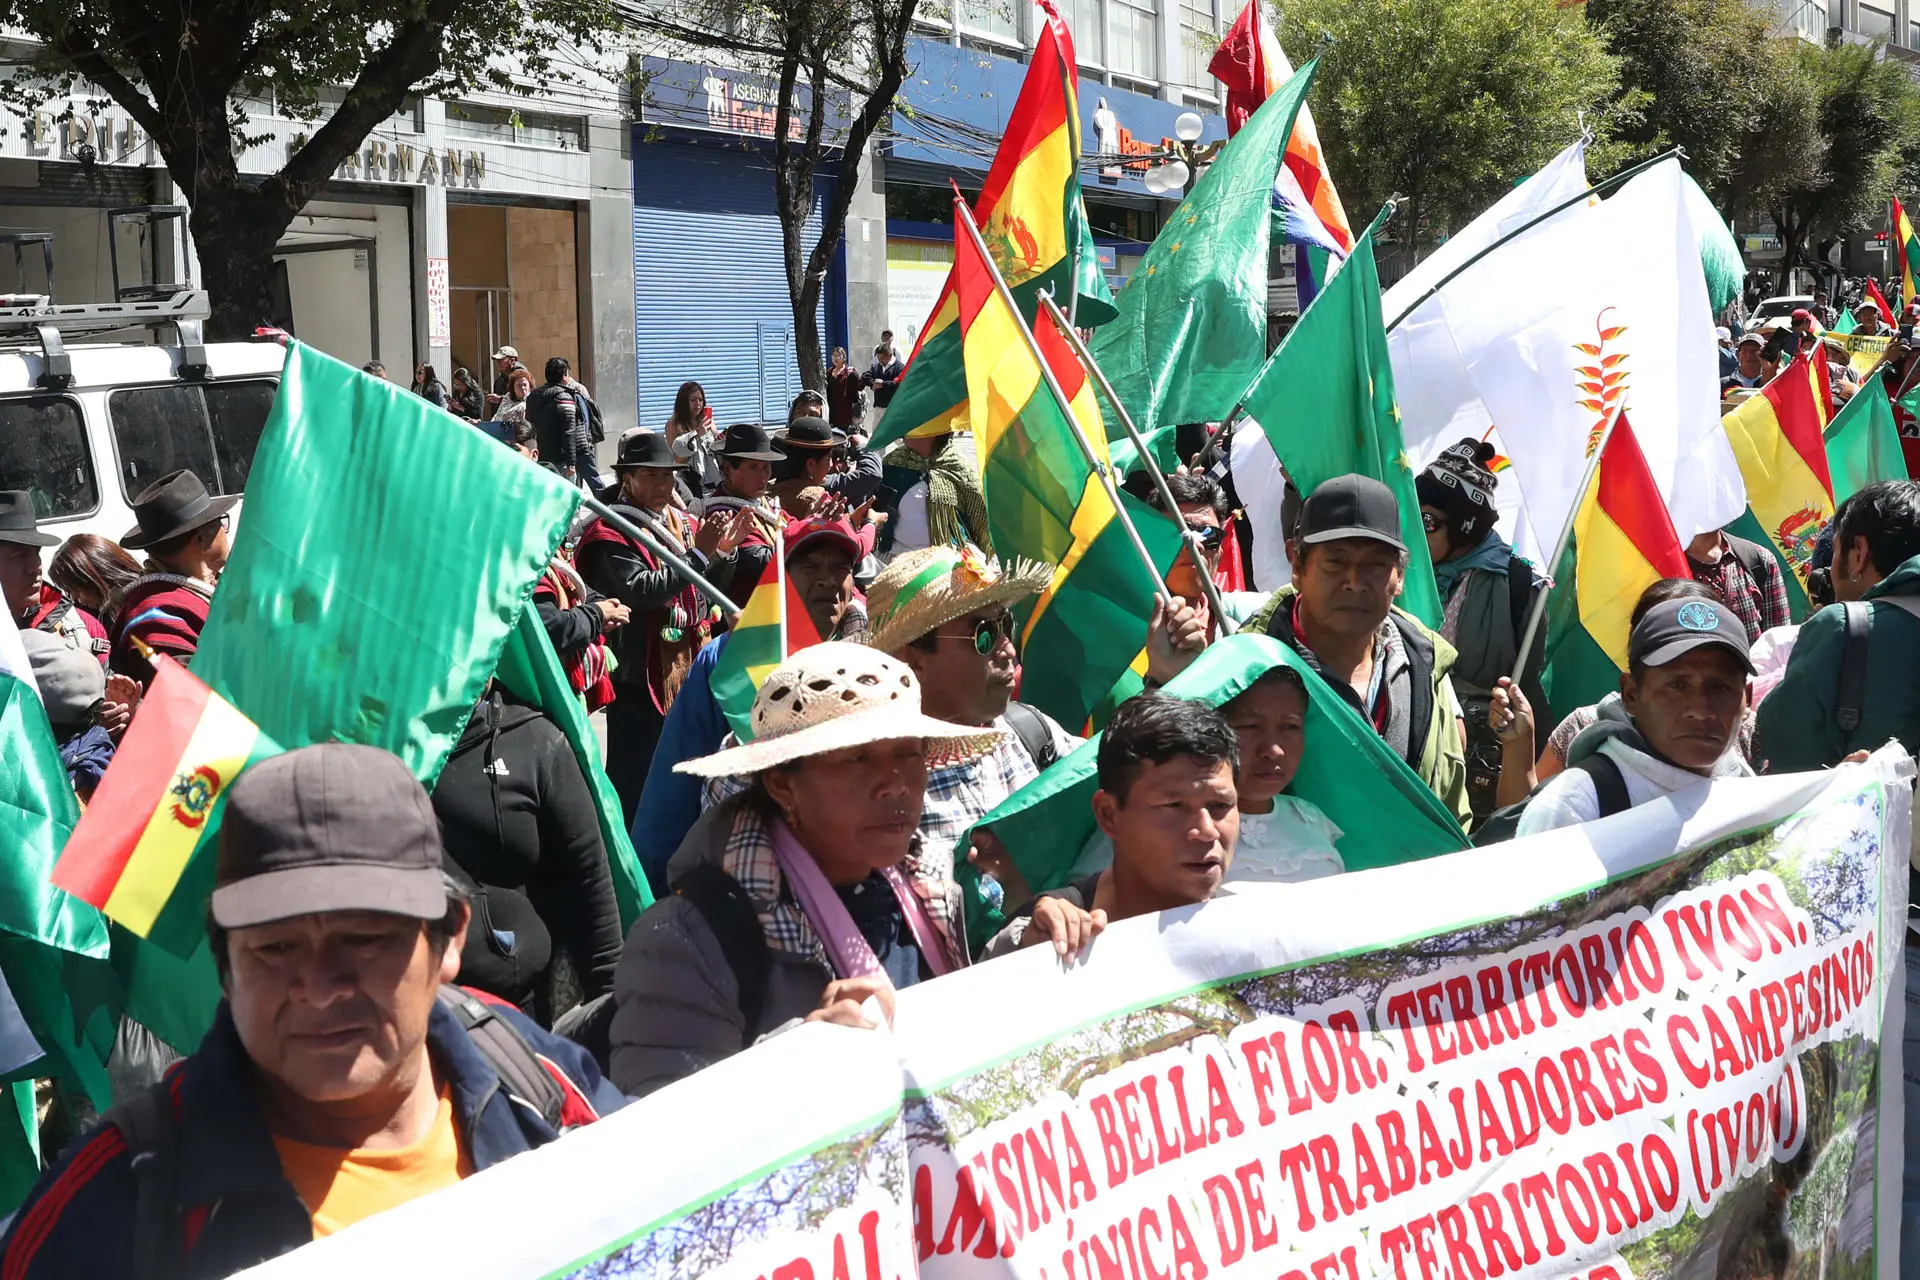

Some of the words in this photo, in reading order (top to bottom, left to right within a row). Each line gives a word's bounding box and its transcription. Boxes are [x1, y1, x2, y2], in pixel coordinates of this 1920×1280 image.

[429, 260, 438, 306] FOTOS
[1475, 776, 1490, 786] CAT
[1090, 1054, 1245, 1189] BELLA
[1387, 920, 1664, 1073] TERRITORIO
[1662, 883, 1807, 981] IVON.
[1202, 1158, 1279, 1268] DE
[1279, 1028, 1668, 1232] TRABAJADORES
[1667, 931, 1874, 1089] CAMPESINOS
[1380, 1134, 1679, 1280] TERRITORIO
